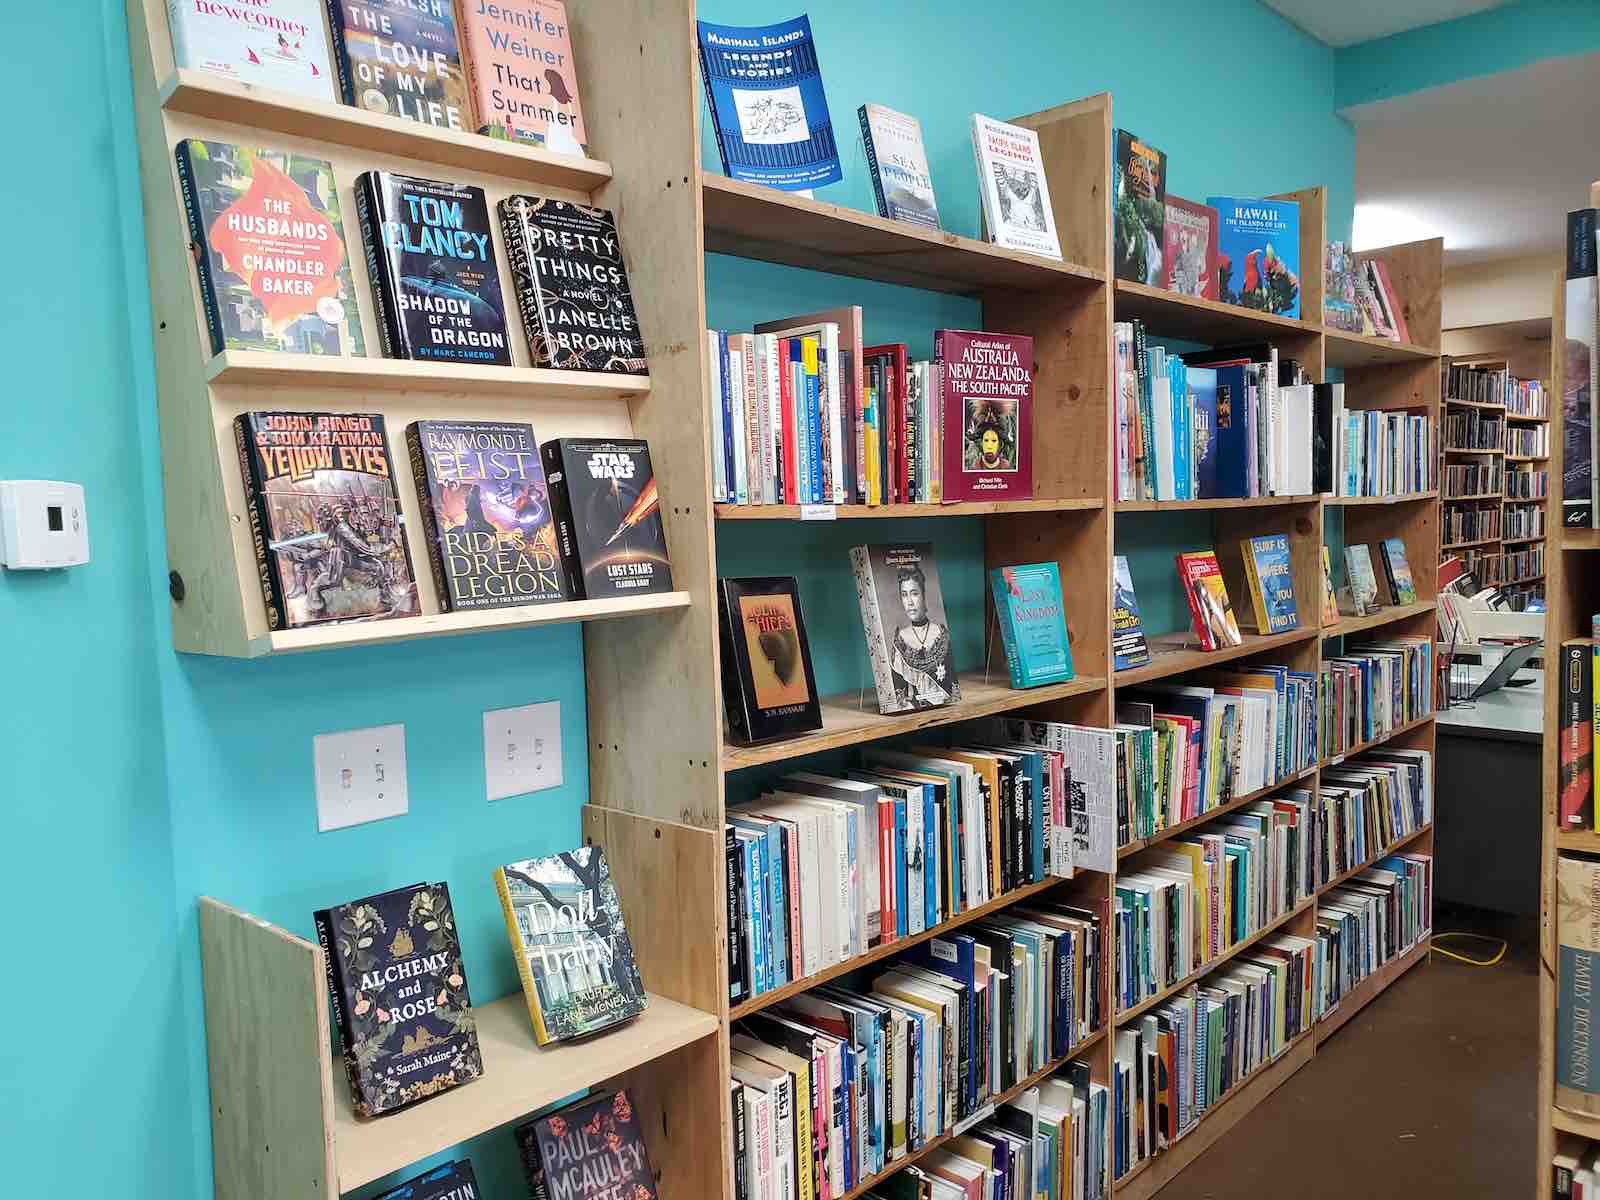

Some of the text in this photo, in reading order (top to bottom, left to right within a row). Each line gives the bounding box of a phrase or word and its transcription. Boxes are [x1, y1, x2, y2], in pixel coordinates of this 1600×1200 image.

[194, 0, 307, 37] newcomer
[349, 6, 393, 34] THE
[478, 0, 564, 38] Jennifer
[486, 27, 564, 67] Weiner
[707, 30, 804, 47] MARSHALL ISLANDS
[374, 37, 449, 79] LOVE
[723, 50, 793, 61] LEGENDS
[358, 63, 426, 94] OF MY
[492, 64, 541, 94] That
[730, 66, 793, 77] STORIES
[396, 94, 462, 130] LIFE
[492, 89, 577, 127] Summer
[263, 198, 291, 214] THE
[403, 194, 464, 230] TOM
[1234, 208, 1279, 221] HAWAII
[228, 213, 328, 241] HUSBANDS
[1239, 219, 1264, 228] ISLANDS
[382, 221, 489, 263] CLANCY
[506, 213, 528, 272] JANELLE
[528, 228, 615, 256] PRETTY
[243, 255, 324, 276] CHANDLER
[535, 257, 620, 285] THINGS
[263, 277, 313, 296] BAKER
[563, 290, 602, 302] A NOVEL
[399, 293, 472, 316] SHADOW
[523, 288, 545, 338] PRETTY
[429, 315, 472, 328] OF THE
[548, 308, 632, 331] JANELLE
[430, 327, 504, 348] DRAGON
[557, 331, 632, 355] BROWN
[970, 339, 990, 349] Cultural
[420, 347, 496, 360] BY MARC CAMERON
[962, 349, 1020, 366] AUSTRALIA
[948, 363, 973, 379] NEW
[951, 380, 1029, 396] THE SOUTH PACIFIC
[265, 415, 371, 432] JOHN RINGO
[256, 431, 382, 445] & TOM KRATMAN
[428, 432, 515, 450] RAYMOND
[259, 446, 334, 483] YELLOW
[343, 446, 389, 478] EYES
[431, 452, 532, 481] FEIST
[587, 453, 634, 467] STAR
[588, 466, 636, 479] WARS
[444, 531, 527, 555] RIDES
[1254, 539, 1286, 554] SURF IS
[448, 551, 556, 577] DREAD
[607, 562, 653, 577] LOST STARS
[1262, 564, 1289, 577] WHERE
[452, 571, 561, 599] LEGION
[1275, 589, 1292, 600] YOU
[457, 599, 475, 607] BOOK
[1271, 614, 1297, 628] FIND IT
[361, 951, 450, 991] ALCHEMY
[398, 982, 422, 999] and
[573, 986, 613, 1004] LAURA
[390, 996, 437, 1025] ROSE
[1571, 953, 1592, 1089] EMILY DICKINSON
[396, 1050, 451, 1076] Sarah Maine
[546, 1131, 600, 1171] PAUL
